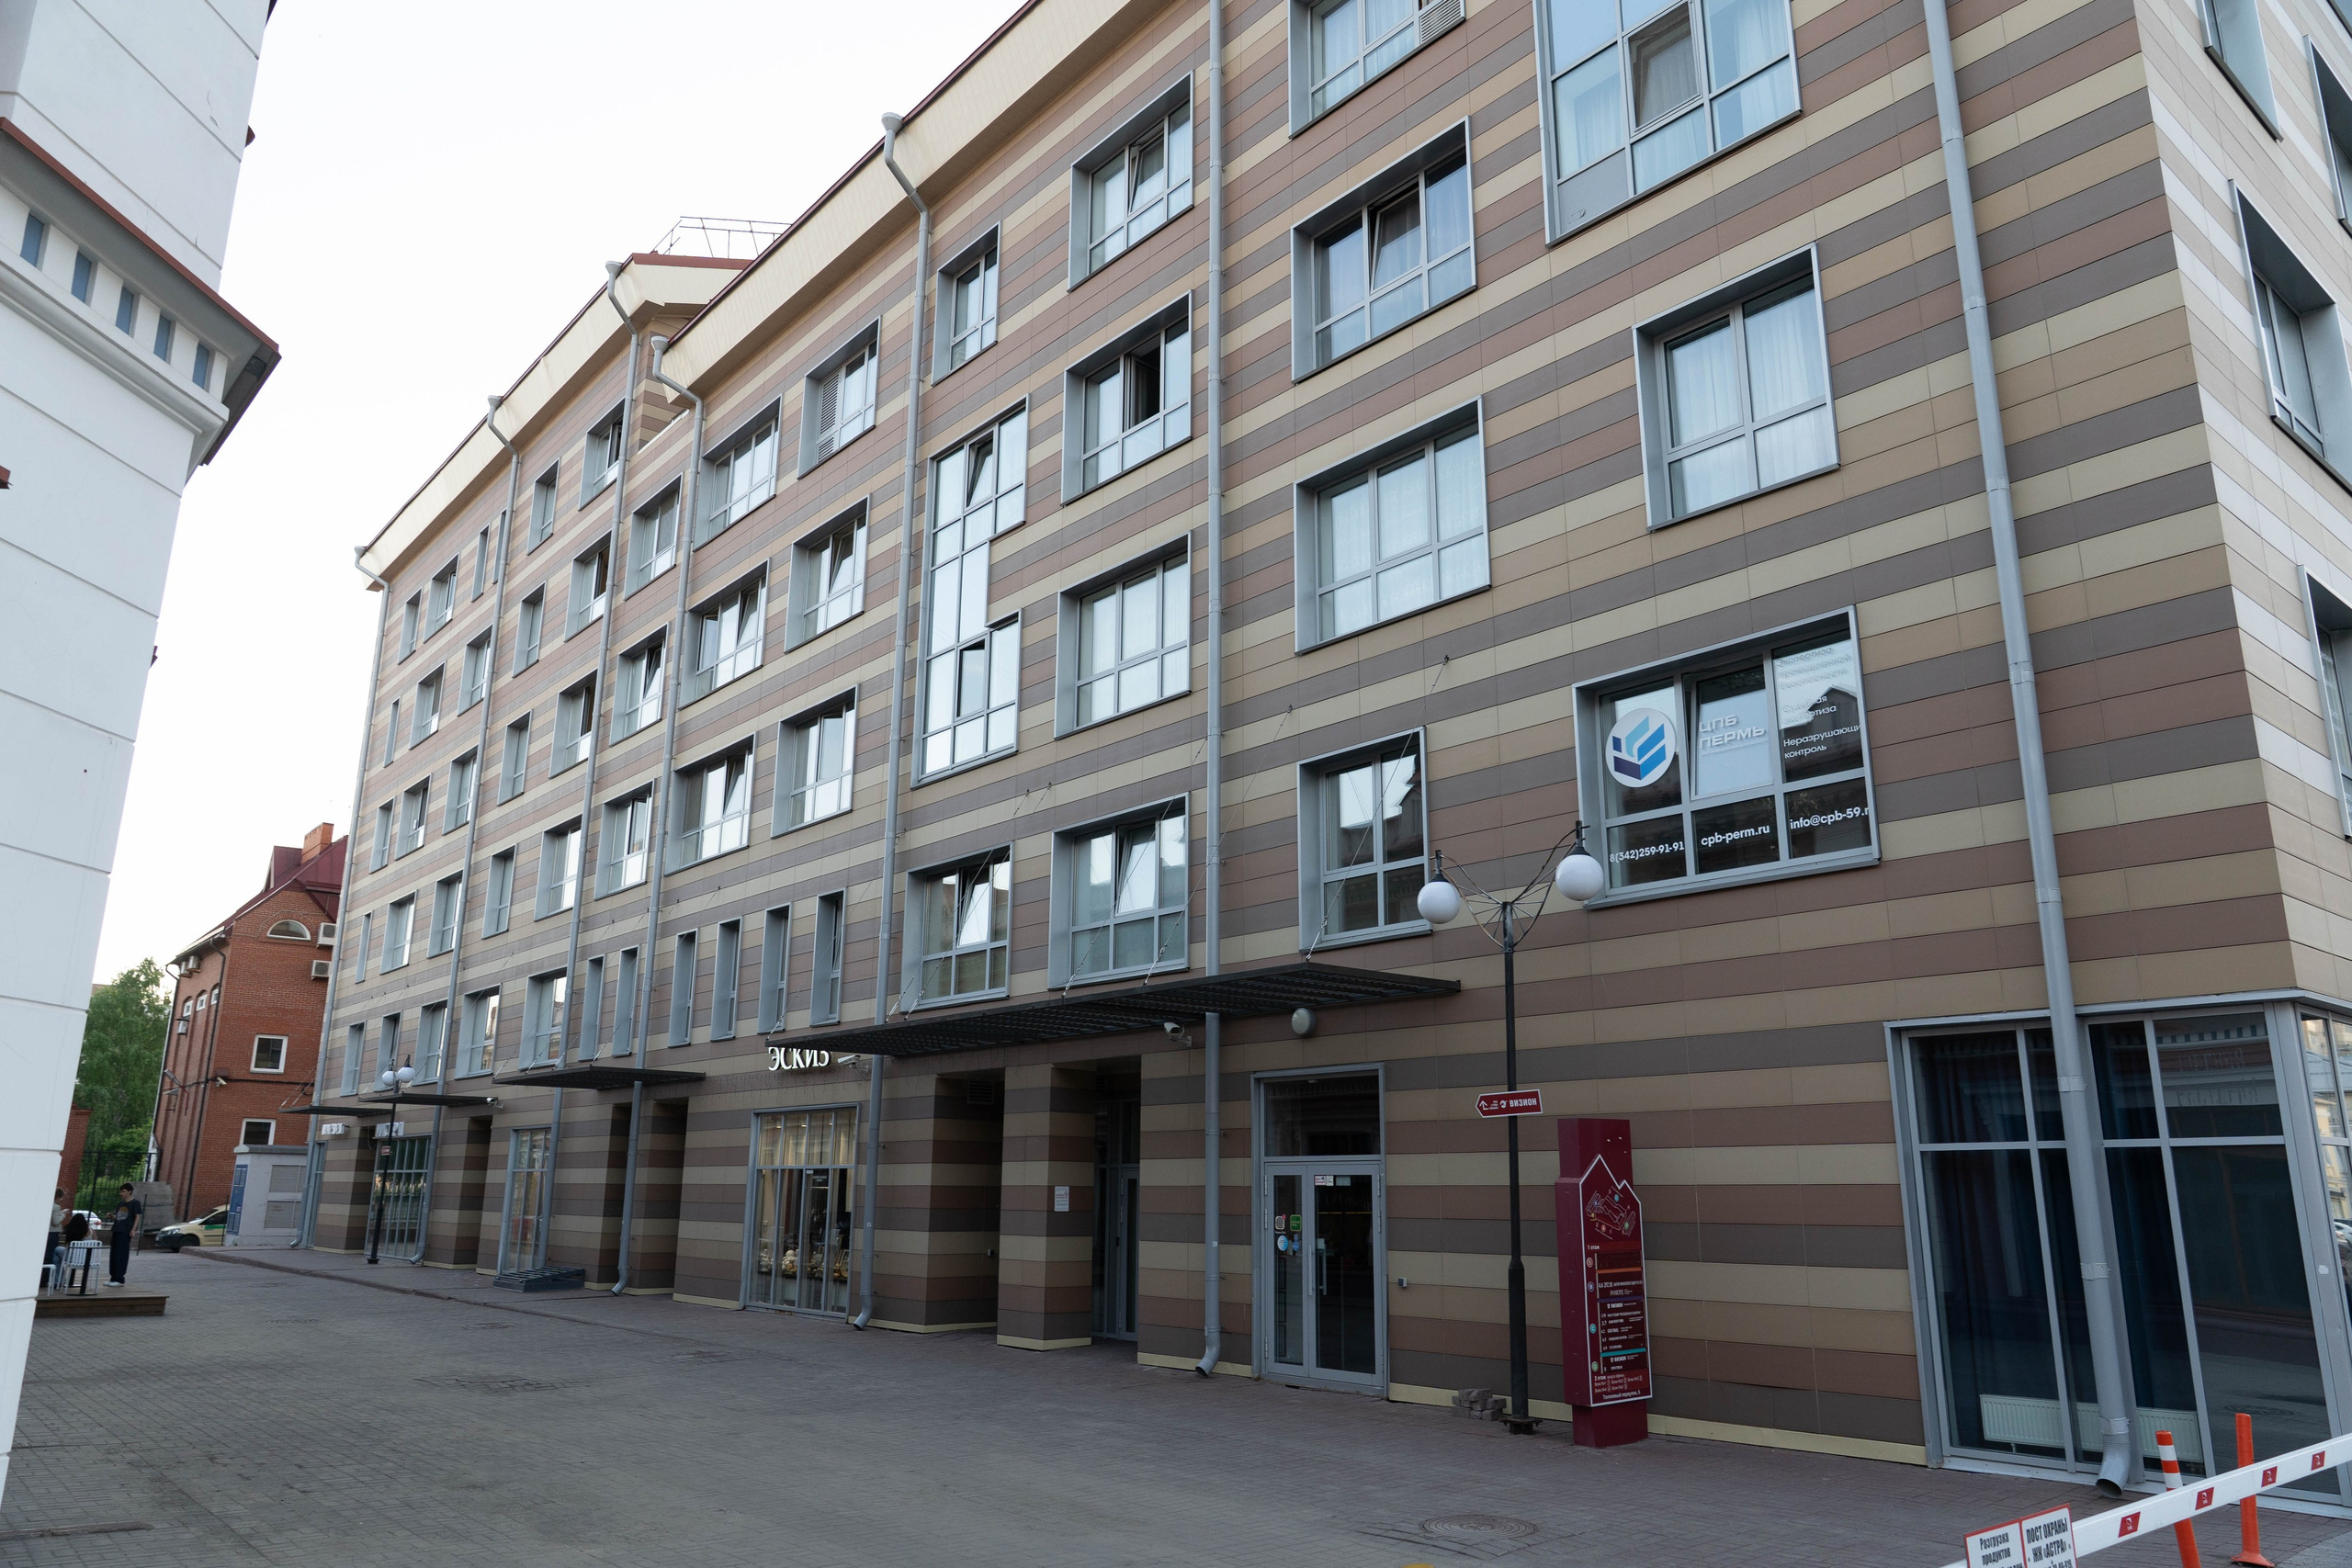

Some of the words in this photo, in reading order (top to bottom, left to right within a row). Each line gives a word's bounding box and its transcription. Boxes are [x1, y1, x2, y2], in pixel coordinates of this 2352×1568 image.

[1699, 715, 1737, 732] ЦПБ
[1699, 726, 1765, 749] ПЕРМЬ
[1784, 745, 1827, 759] контроль
[1702, 825, 1770, 847] cpb-perm.ru
[1610, 841, 1684, 863] 8(342)259-91-91
[1510, 1098, 1537, 1108] ВИЗИОН
[2026, 1525, 2042, 1544] ПОСТ
[2043, 1517, 2068, 1539] ОХРАНЫ
[1979, 1532, 2009, 1551] Разгрузка
[1982, 1548, 2011, 1566] продуктов
[2031, 1545, 2043, 1562] ЖК
